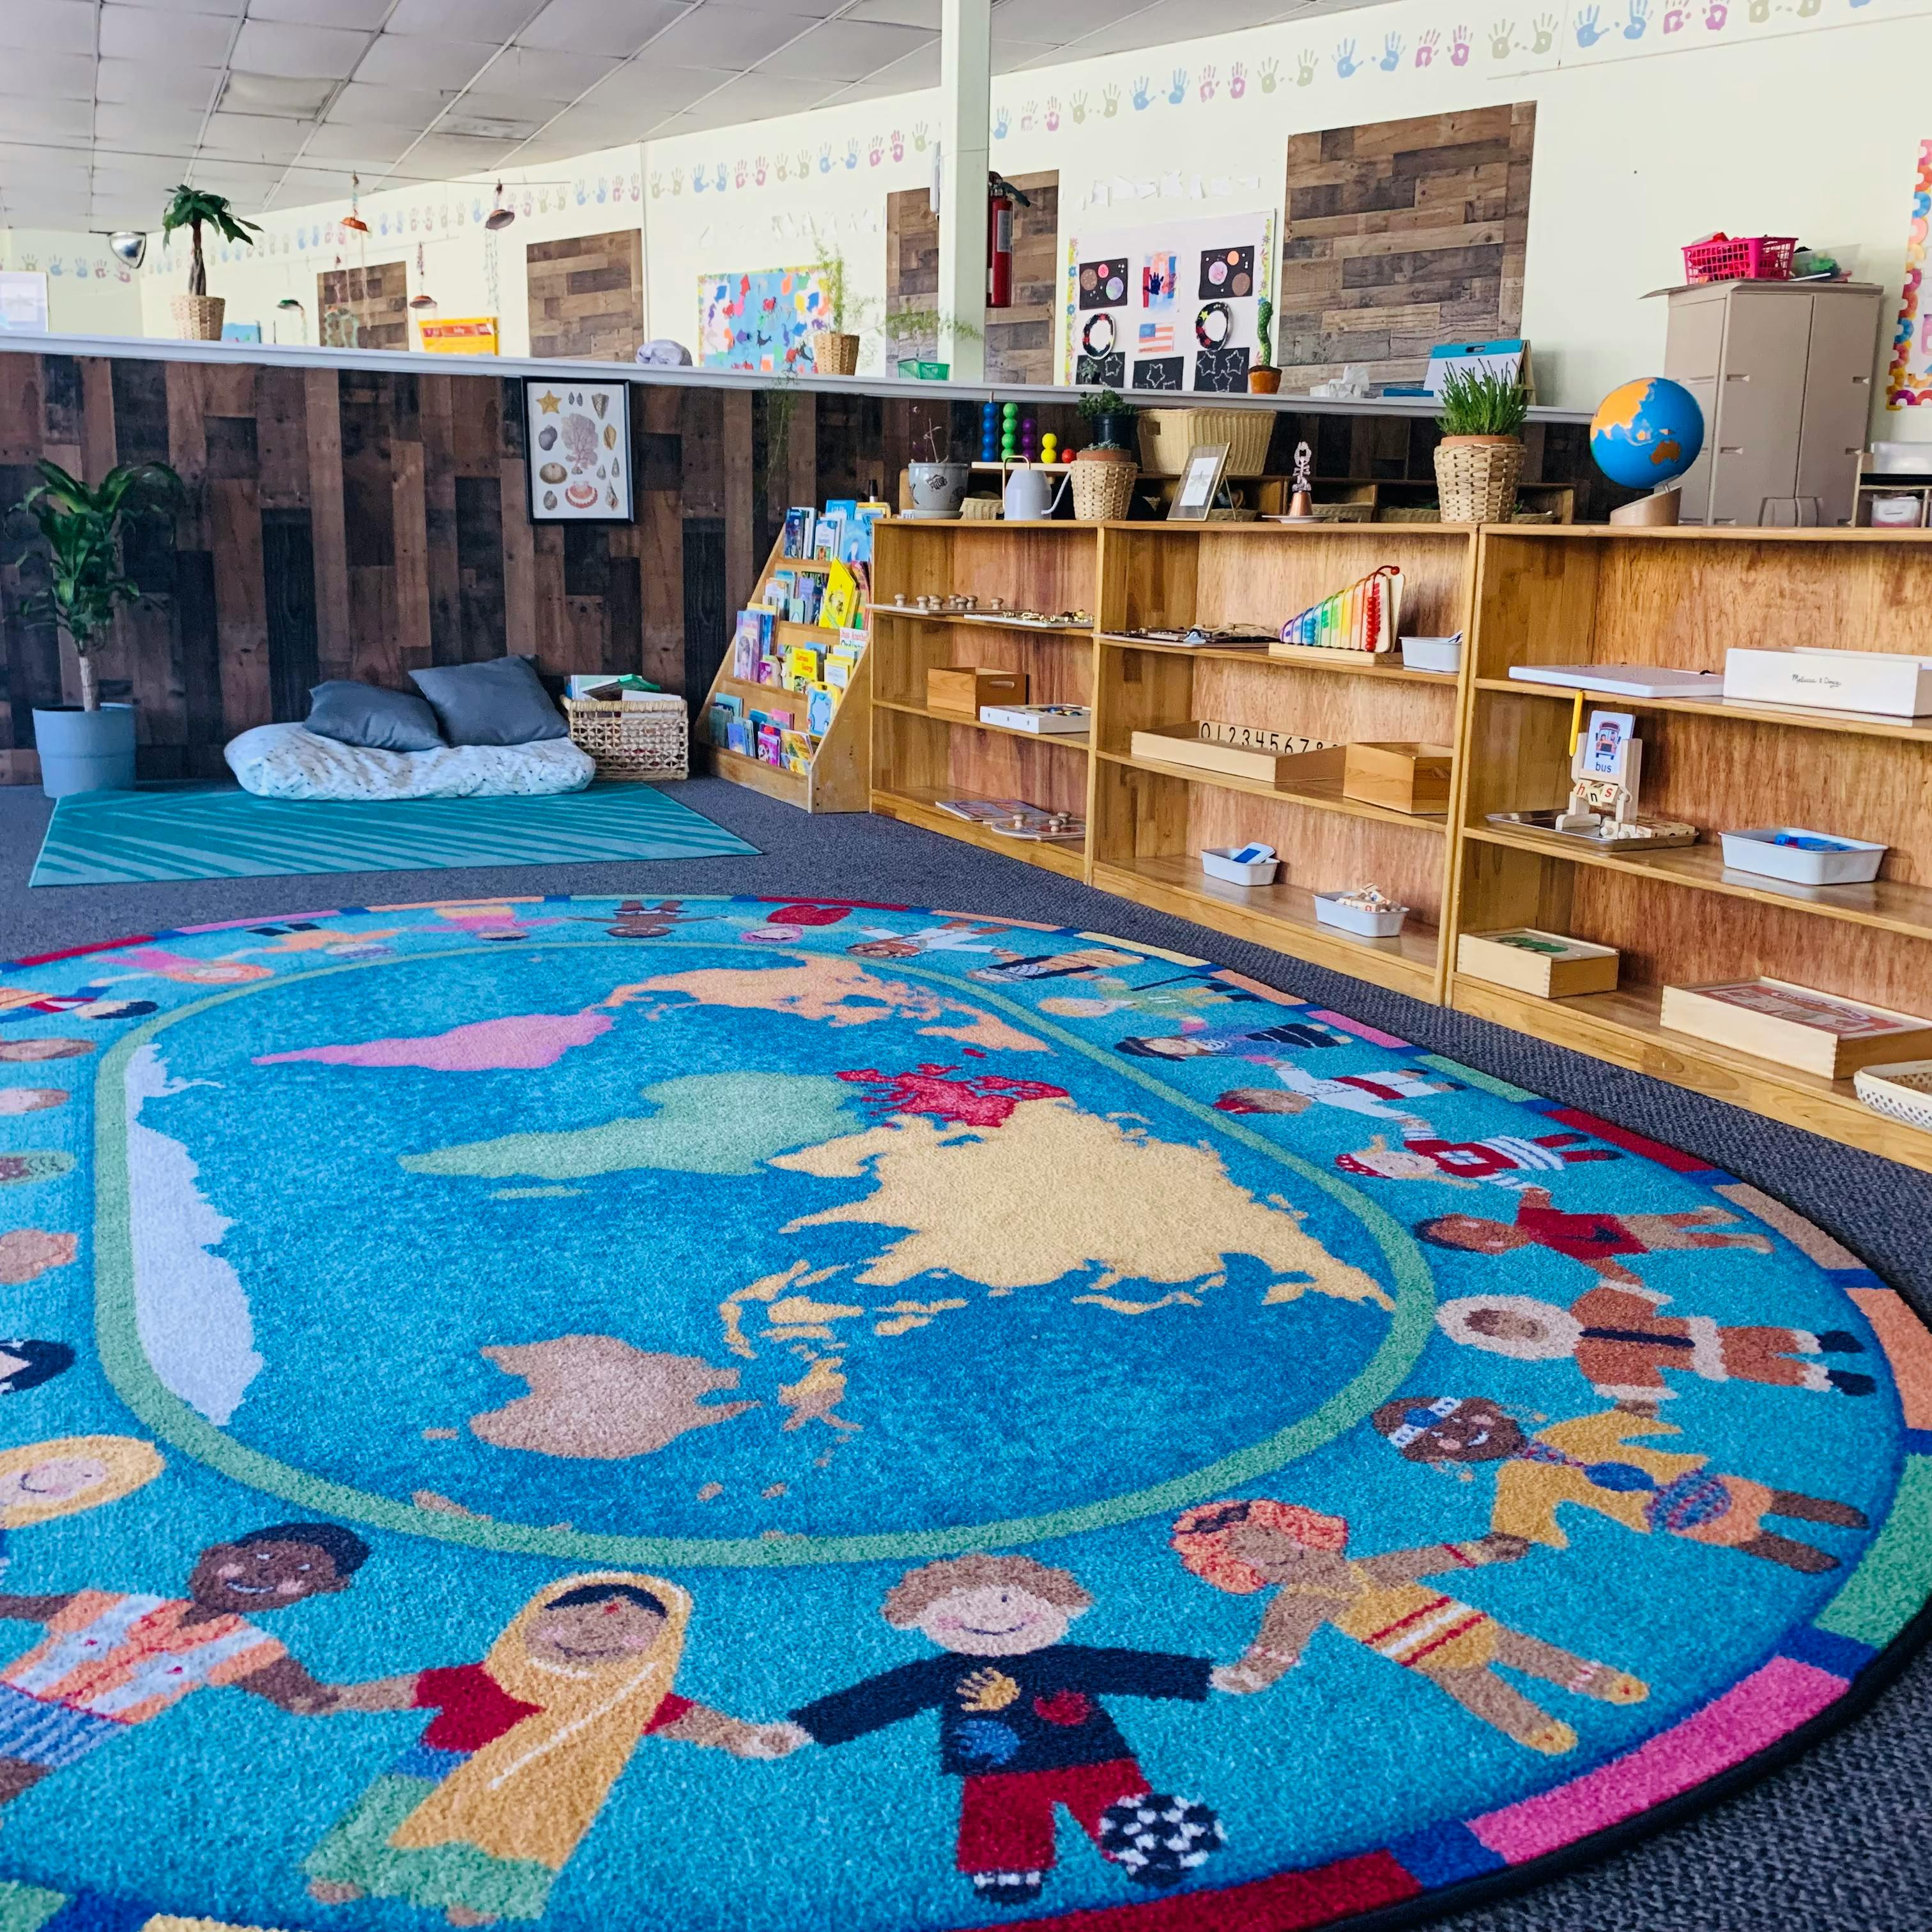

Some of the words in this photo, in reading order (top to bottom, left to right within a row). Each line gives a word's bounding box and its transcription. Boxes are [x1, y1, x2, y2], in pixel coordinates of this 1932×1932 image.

[1596, 762, 1611, 772] bus
[1577, 783, 1585, 795] h
[1604, 787, 1613, 797] s
[1590, 792, 1598, 802] n
